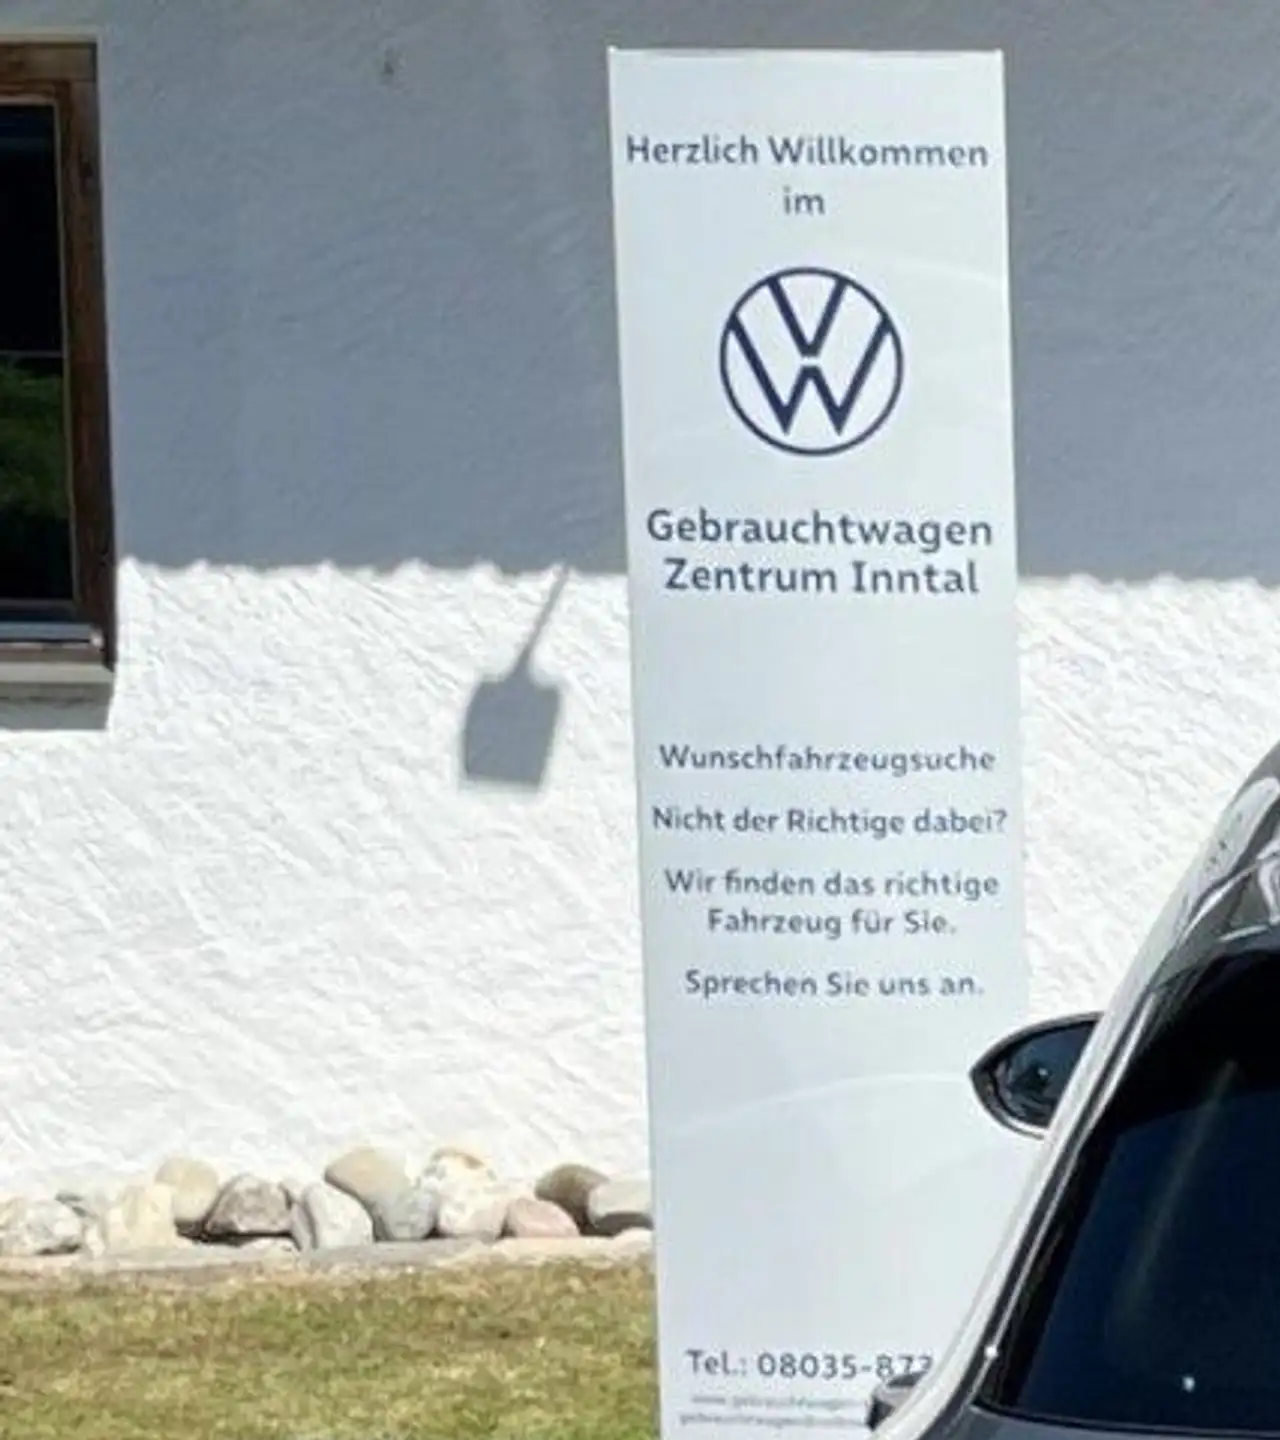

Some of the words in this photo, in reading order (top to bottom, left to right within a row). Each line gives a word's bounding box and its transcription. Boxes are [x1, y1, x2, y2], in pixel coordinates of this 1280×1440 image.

[626, 134, 759, 166] Herzlich
[768, 136, 990, 168] Willkommen
[783, 186, 826, 216] im
[646, 508, 993, 554] Gebrauchtwagen
[664, 558, 838, 593] Zentrum
[852, 560, 980, 595] Inntal
[659, 744, 996, 777] Wunschfahrzeugsuche
[651, 806, 725, 833] Nicht
[732, 807, 780, 833] der
[786, 808, 904, 840] Richtige
[912, 808, 1009, 834] dabei?
[664, 868, 714, 895] Wir
[724, 868, 816, 895] finden
[823, 869, 875, 896] das
[883, 870, 1000, 901] richtige
[707, 908, 842, 939] Fahrzeug
[851, 907, 894, 934] für
[904, 909, 957, 935] Sie.
[685, 969, 818, 999] Sprechen
[827, 970, 870, 997] Sie
[878, 974, 930, 997] uns
[939, 974, 986, 997] an.
